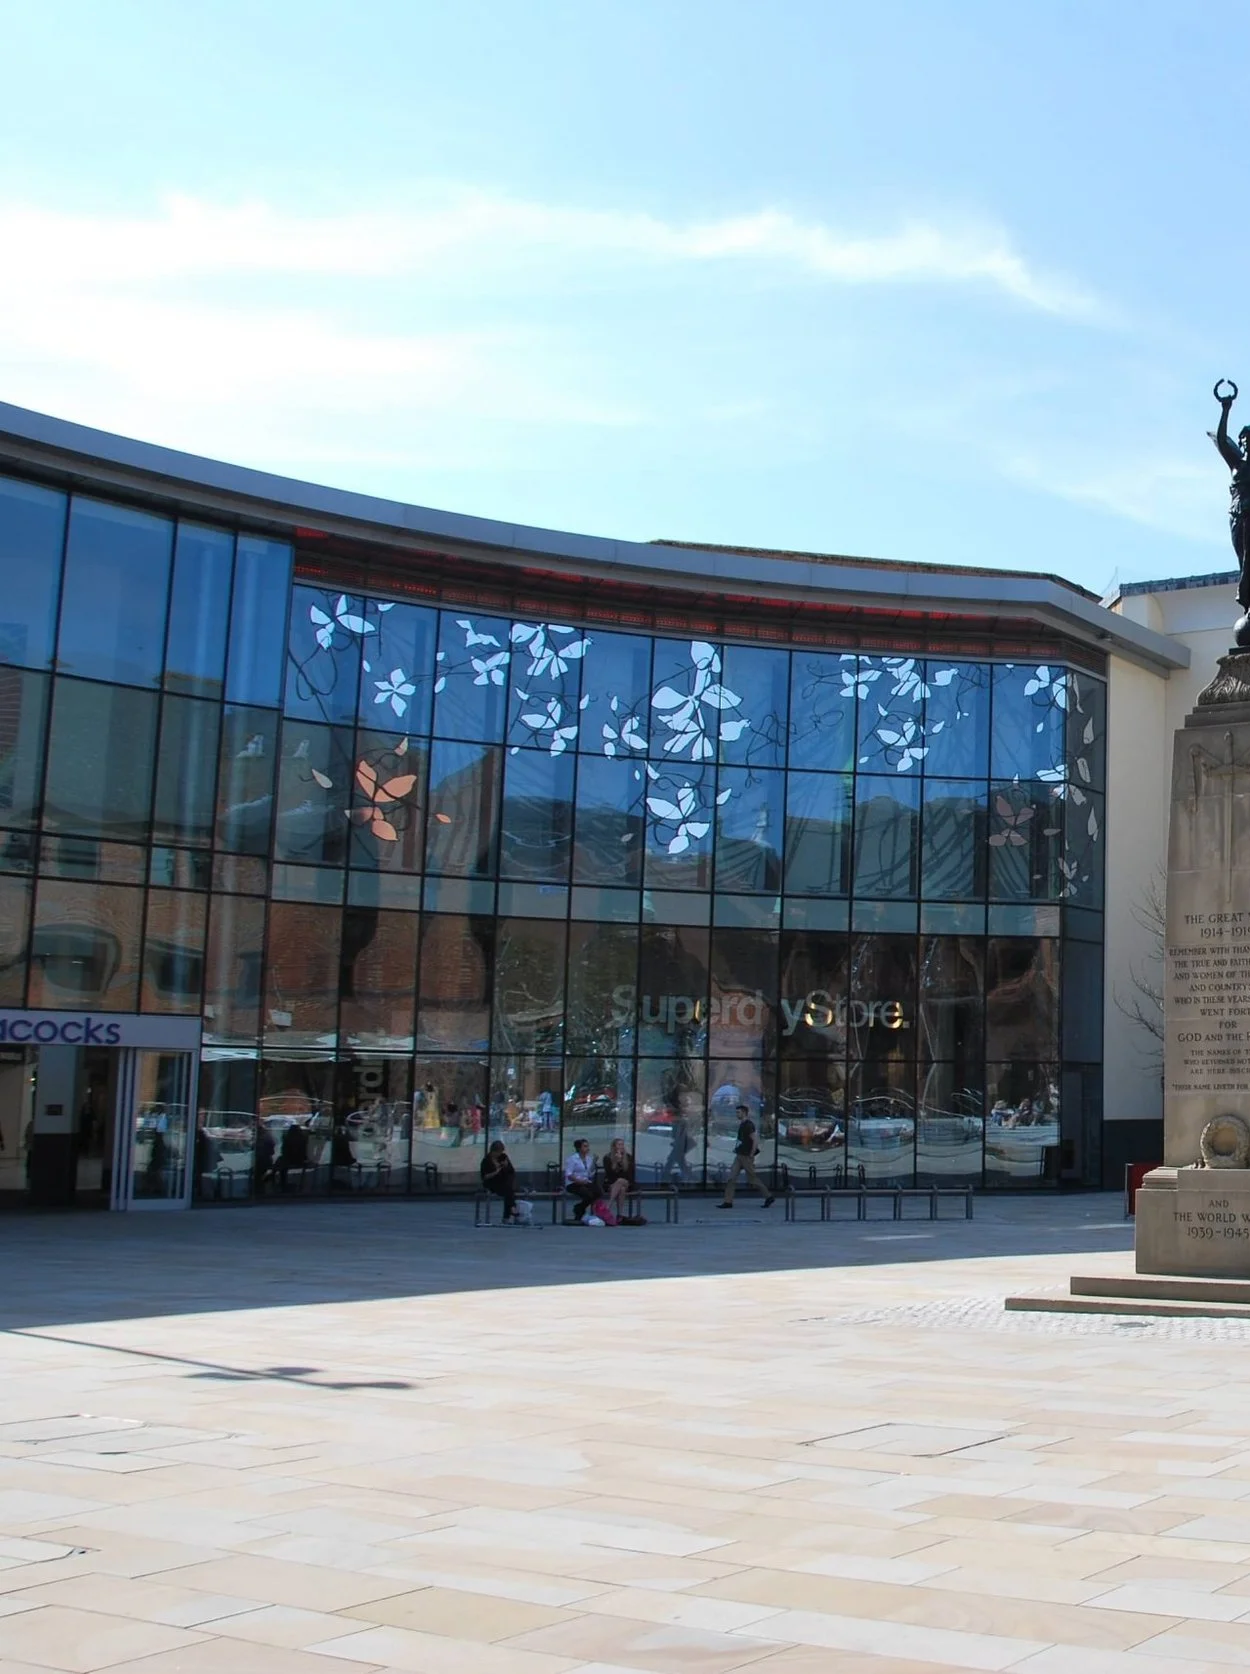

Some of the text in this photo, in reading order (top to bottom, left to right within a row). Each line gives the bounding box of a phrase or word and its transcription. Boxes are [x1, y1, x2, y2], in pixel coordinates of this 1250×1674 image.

[1184, 914, 1205, 925] THE
[1208, 912, 1244, 923] GREAT
[1169, 946, 1207, 956] REMEMBER
[1209, 945, 1230, 955] WITH
[1174, 960, 1188, 968] THE
[1191, 959, 1211, 968] TRUE
[1212, 958, 1228, 967] AND
[1174, 972, 1190, 981] AND
[1192, 971, 1224, 980] WOMEN
[1226, 970, 1237, 978] OF
[1189, 983, 1206, 992] AND
[1174, 996, 1192, 1005] WHO
[1202, 996, 1225, 1004] THESE
[1200, 1008, 1226, 1016] WENT
[1219, 1021, 1238, 1029] FOR
[1177, 1032, 1202, 1042] GOD
[1205, 1033, 1223, 1041] AND
[1226, 1033, 1244, 1041] THE
[1208, 1200, 1229, 1208] AND
[1173, 1211, 1193, 1222] THE
[1197, 1212, 1236, 1224] WORLD
[1187, 1227, 1250, 1239] 1939-1945
